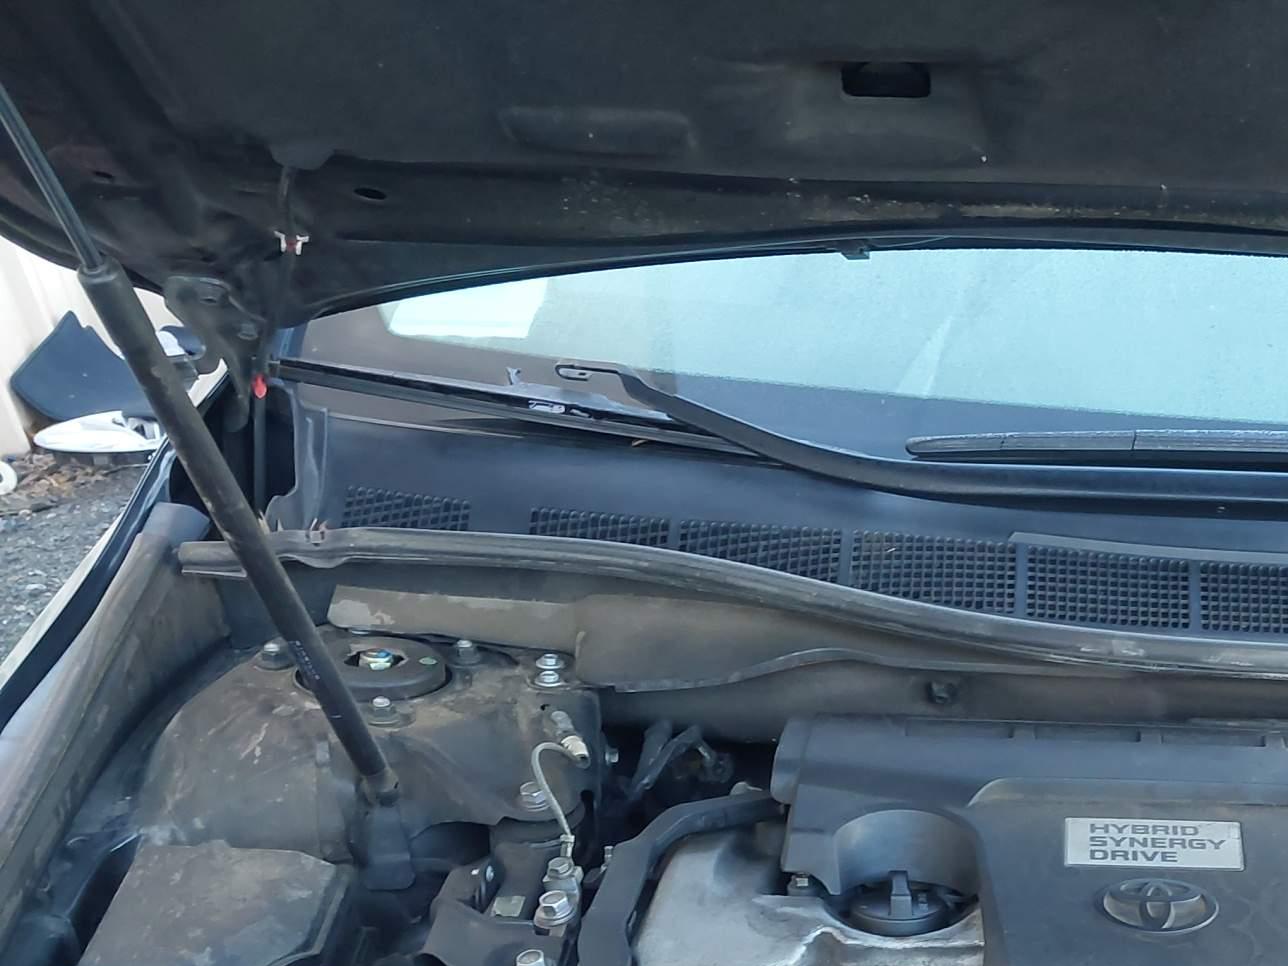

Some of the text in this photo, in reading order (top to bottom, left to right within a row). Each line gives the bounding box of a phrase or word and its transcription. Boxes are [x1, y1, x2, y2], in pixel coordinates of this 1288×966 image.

[1090, 824, 1199, 835] HYBRID
[1090, 837, 1226, 850] SYNERGY
[1090, 850, 1178, 862] DRIVE
